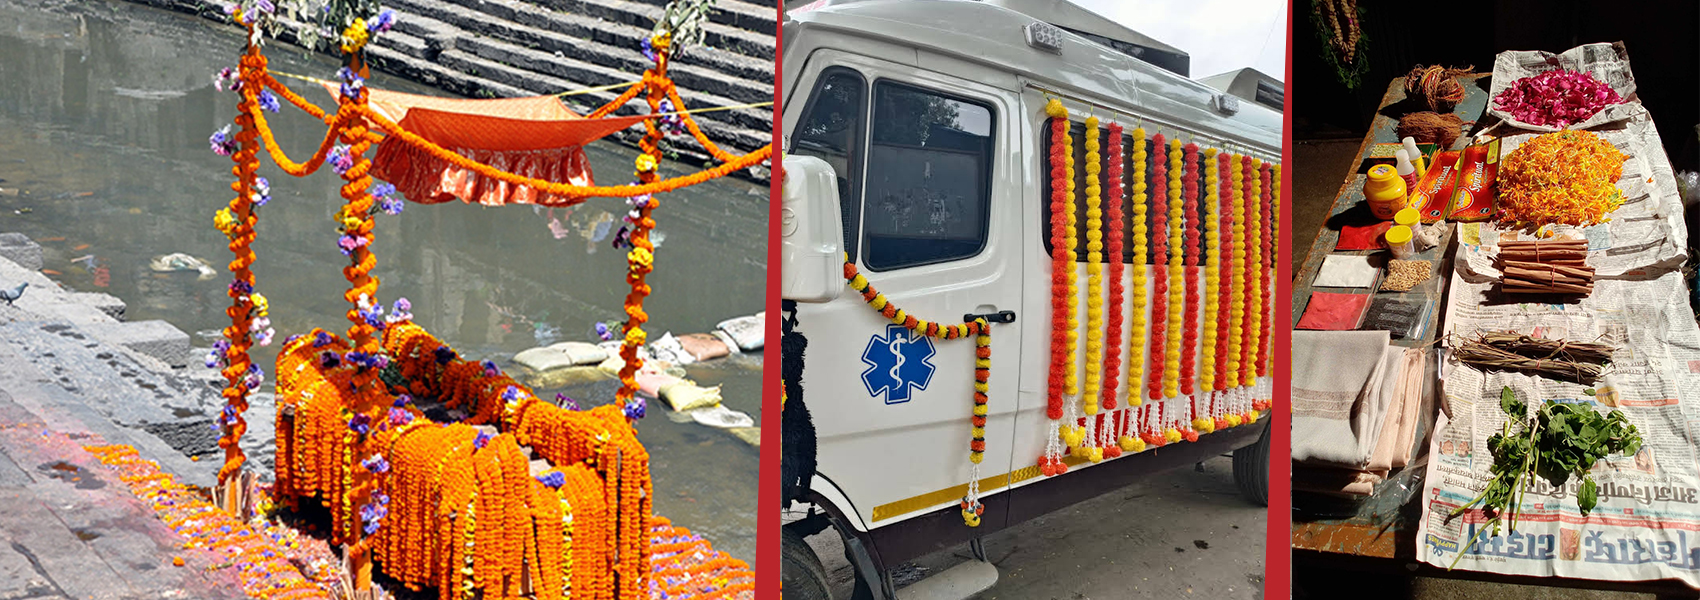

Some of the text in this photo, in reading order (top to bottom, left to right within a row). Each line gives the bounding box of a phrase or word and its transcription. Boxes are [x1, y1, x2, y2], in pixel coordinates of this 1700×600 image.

[1429, 165, 1452, 195] Spiritual
[1468, 161, 1485, 193] Spiritual
[1654, 485, 1699, 505] आज
[1584, 530, 1700, 570] महाराष्ट्र
